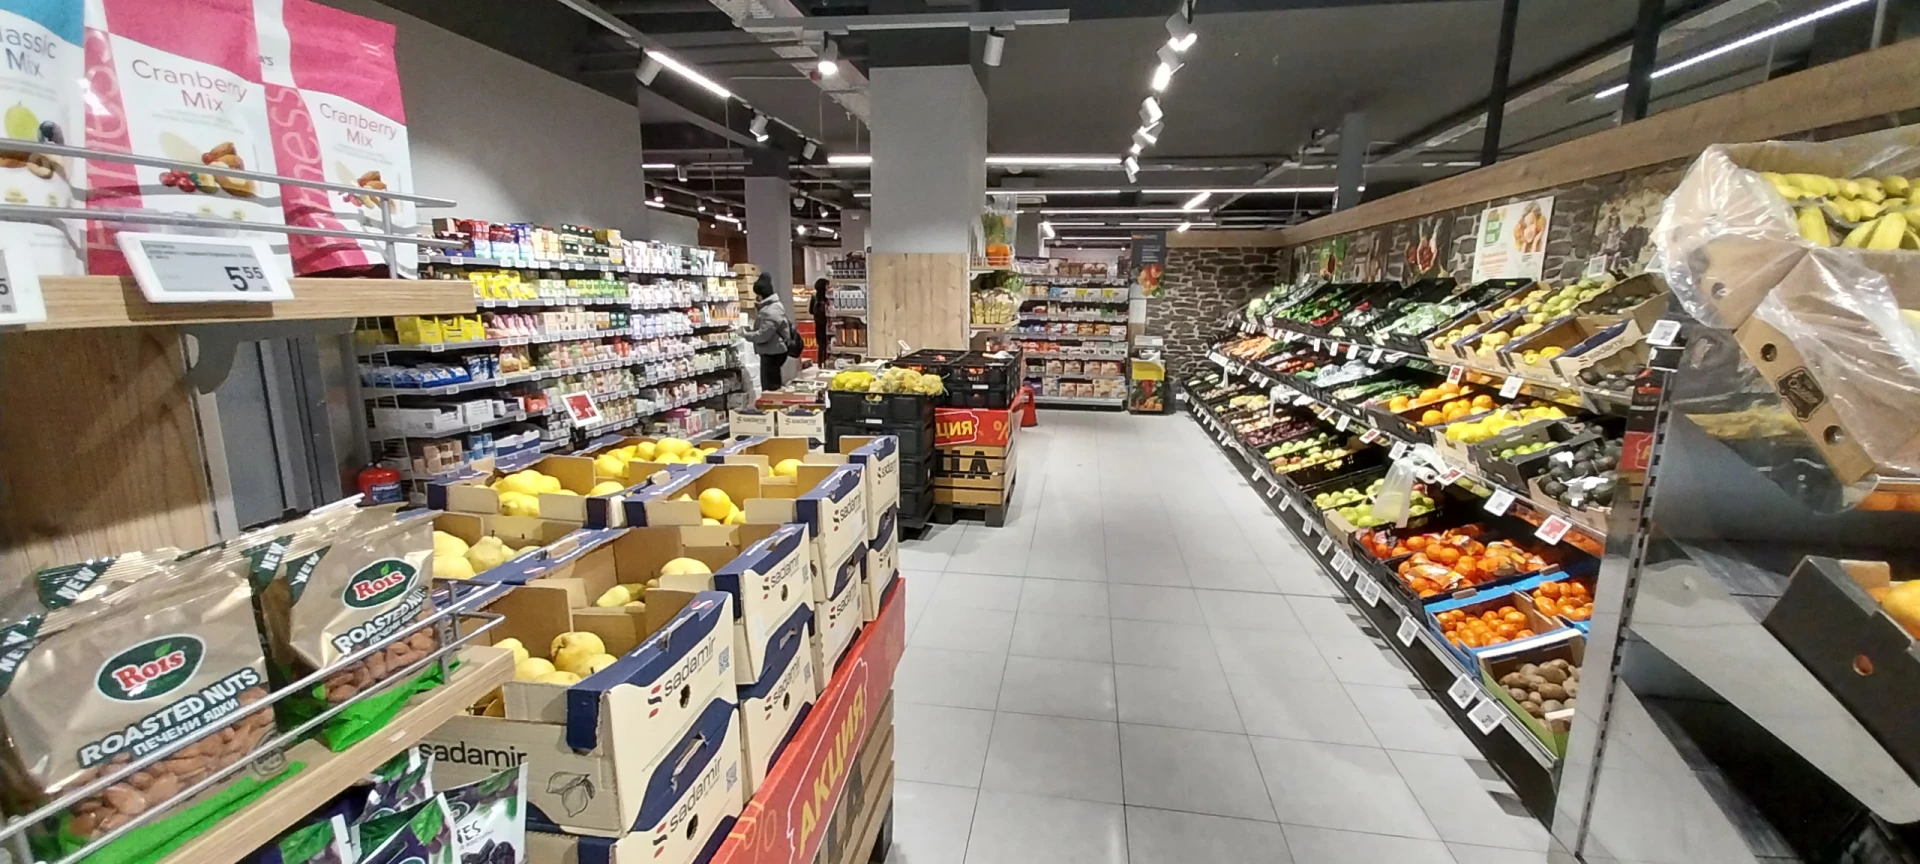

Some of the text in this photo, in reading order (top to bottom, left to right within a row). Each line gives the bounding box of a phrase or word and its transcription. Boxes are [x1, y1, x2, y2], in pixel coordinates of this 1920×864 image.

[5, 48, 45, 79] Mix
[132, 58, 248, 103] Cranberry
[181, 89, 225, 114] Mix
[319, 103, 397, 141] Cranberry
[346, 127, 374, 149] Mix
[936, 420, 973, 439] ЦИЯ
[259, 541, 284, 572] NEW
[292, 551, 321, 585] NEW
[770, 551, 801, 588] sadamir
[55, 566, 97, 600] NEW
[332, 603, 410, 655] ROASTED
[665, 637, 716, 697] sadamir
[773, 656, 801, 706] sadamir
[80, 697, 205, 766] ROASTED
[207, 668, 259, 708] NUTS
[132, 697, 240, 756] ПЕЧЕНИ ЯДКИ
[419, 740, 528, 769] sadamir
[799, 683, 865, 861] АКЦИЯ
[670, 756, 722, 833] sadamir
